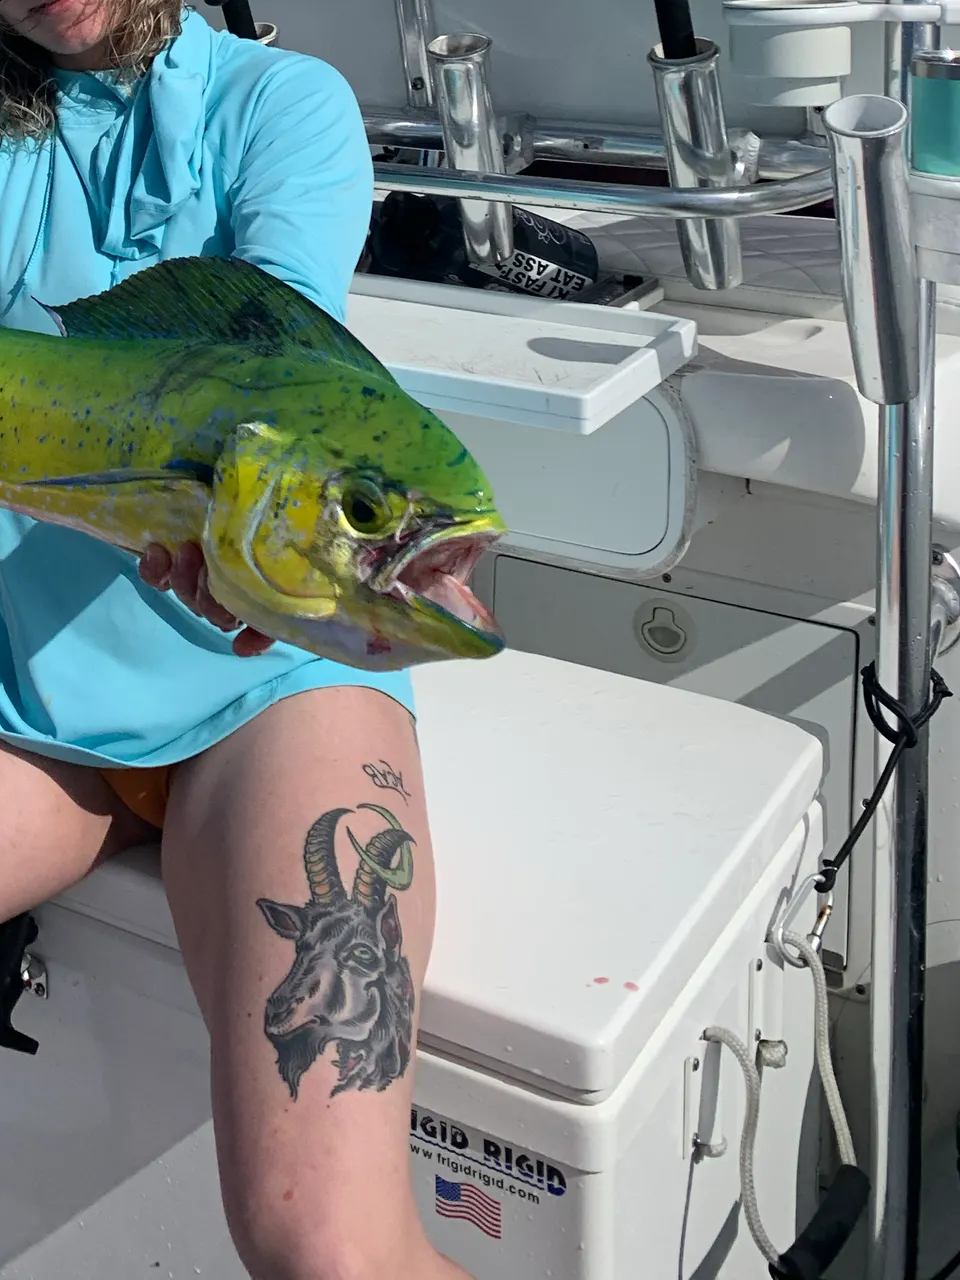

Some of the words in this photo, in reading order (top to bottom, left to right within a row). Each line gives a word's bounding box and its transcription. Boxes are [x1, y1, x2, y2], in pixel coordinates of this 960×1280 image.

[512, 253, 549, 277] ASS
[549, 269, 586, 292] EAT
[410, 1109, 469, 1149] IGID
[483, 1138, 567, 1197] RIGID
